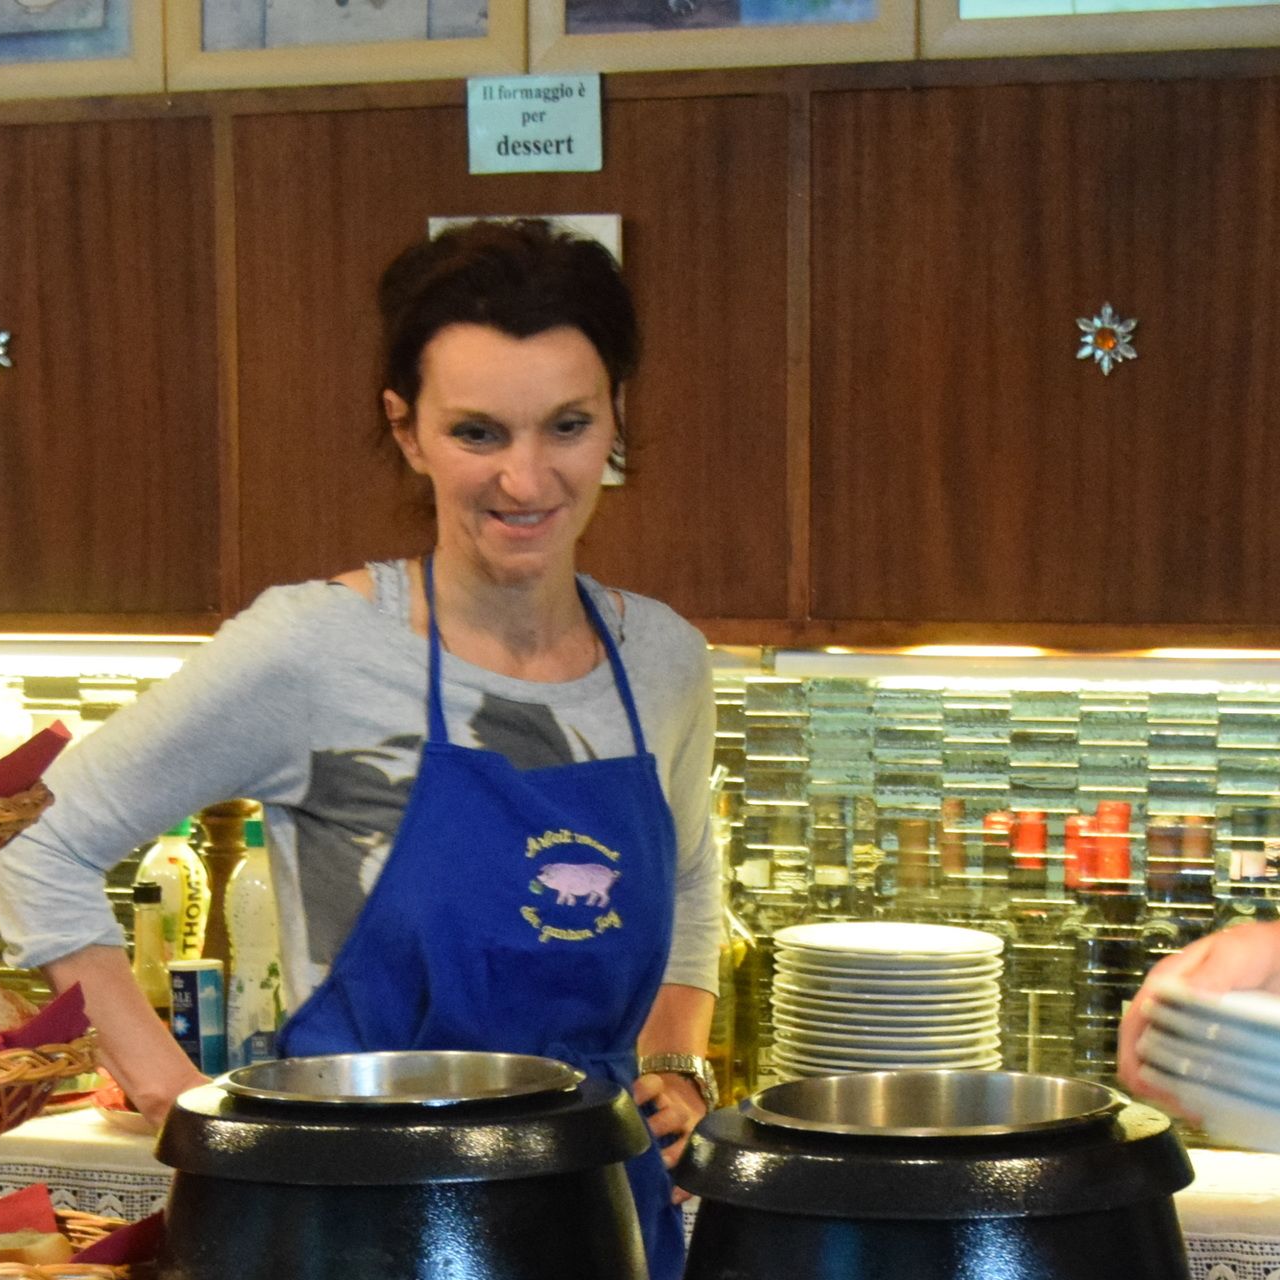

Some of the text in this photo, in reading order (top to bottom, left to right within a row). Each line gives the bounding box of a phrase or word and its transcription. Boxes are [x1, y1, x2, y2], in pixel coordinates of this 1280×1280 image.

[482, 82, 586, 102] Il formaggio è
[521, 110, 546, 127] per
[496, 135, 574, 156] dessert
